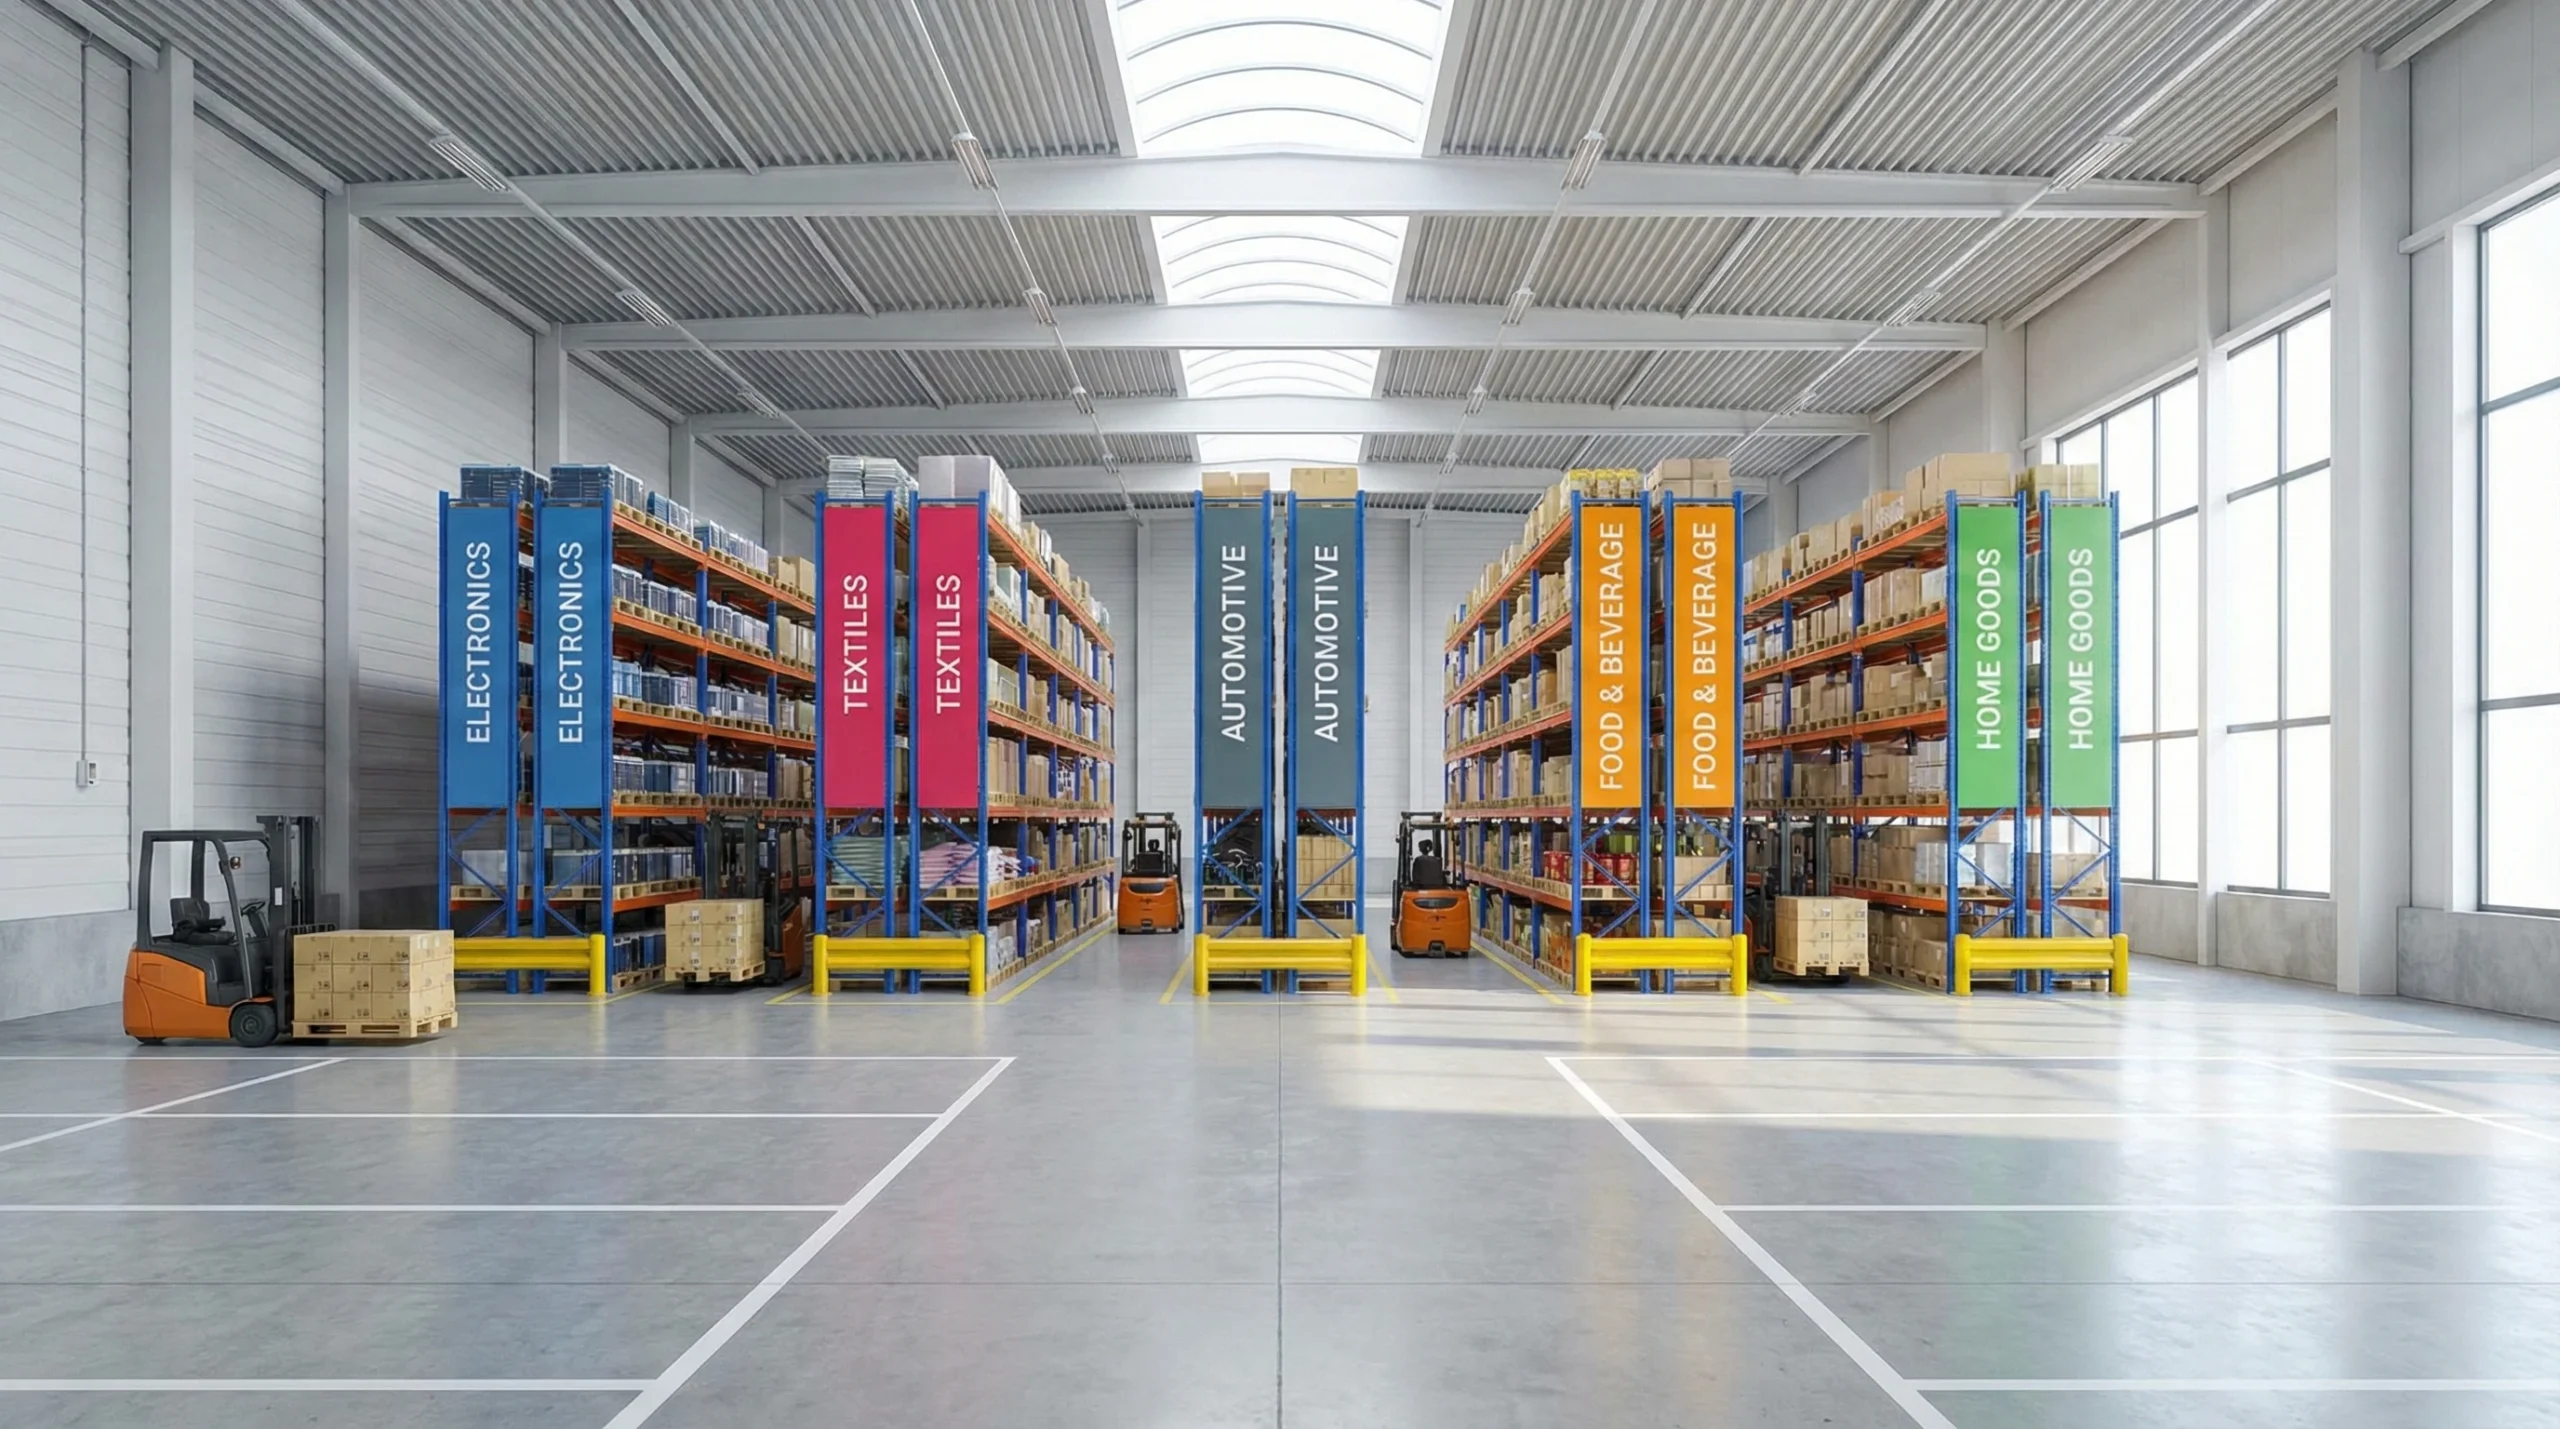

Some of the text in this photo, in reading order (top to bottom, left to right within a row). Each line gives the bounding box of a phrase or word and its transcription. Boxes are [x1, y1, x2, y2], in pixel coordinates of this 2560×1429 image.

[466, 542, 491, 743] ELECTRONICS
[558, 542, 583, 743] ELECTRONICS
[843, 574, 868, 714] TEXTILES
[936, 574, 961, 714] TEXTILES
[1221, 545, 1246, 742] AUTOMOTIVE
[1314, 545, 1339, 743] AUTOMOTIVE
[1599, 523, 1624, 789] FOOD & BEVERAGE
[1692, 523, 1717, 790] FOOD & BEVERAGE
[1976, 548, 2001, 750] HOME GOODS
[2068, 548, 2094, 749] HOME GOODS
